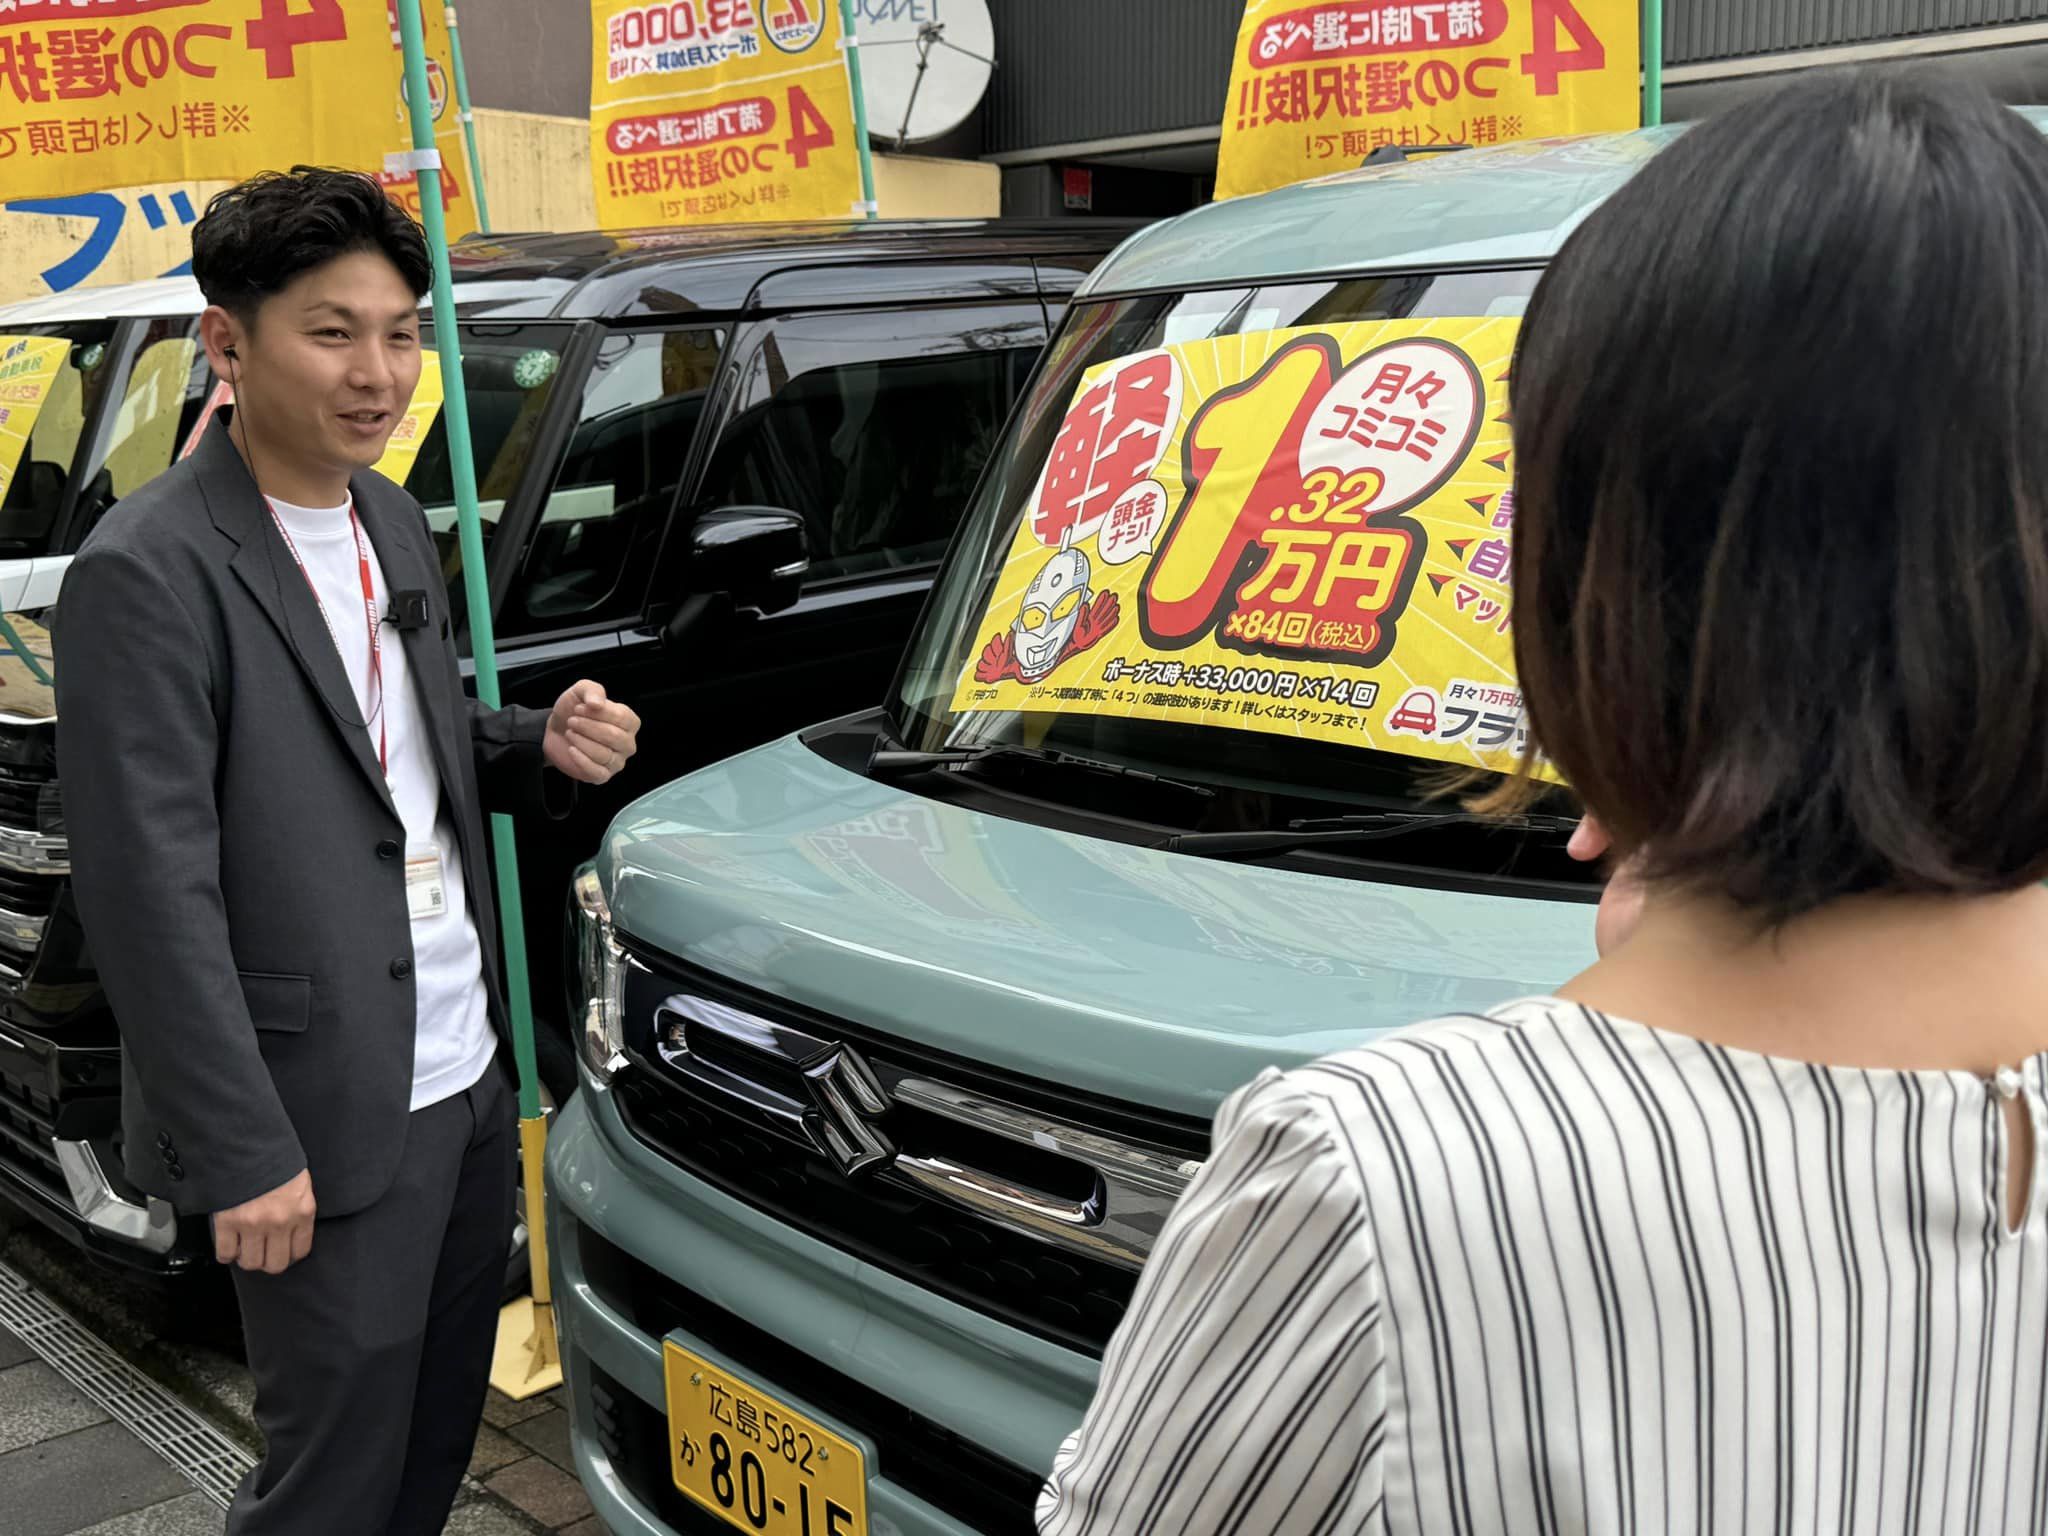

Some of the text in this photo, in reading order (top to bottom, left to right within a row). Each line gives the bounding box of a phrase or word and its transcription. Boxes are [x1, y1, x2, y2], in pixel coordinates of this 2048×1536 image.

[1361, 363, 1446, 409] 月々
[1034, 353, 1172, 545] 軽
[1319, 404, 1447, 462] コミコミ
[1150, 348, 1324, 604] 1
[1110, 491, 1157, 529] 頭金
[1106, 517, 1151, 552] ナシ!
[1239, 528, 1408, 611] 万円
[1468, 538, 1512, 583] 自
[680, 1430, 702, 1467] か
